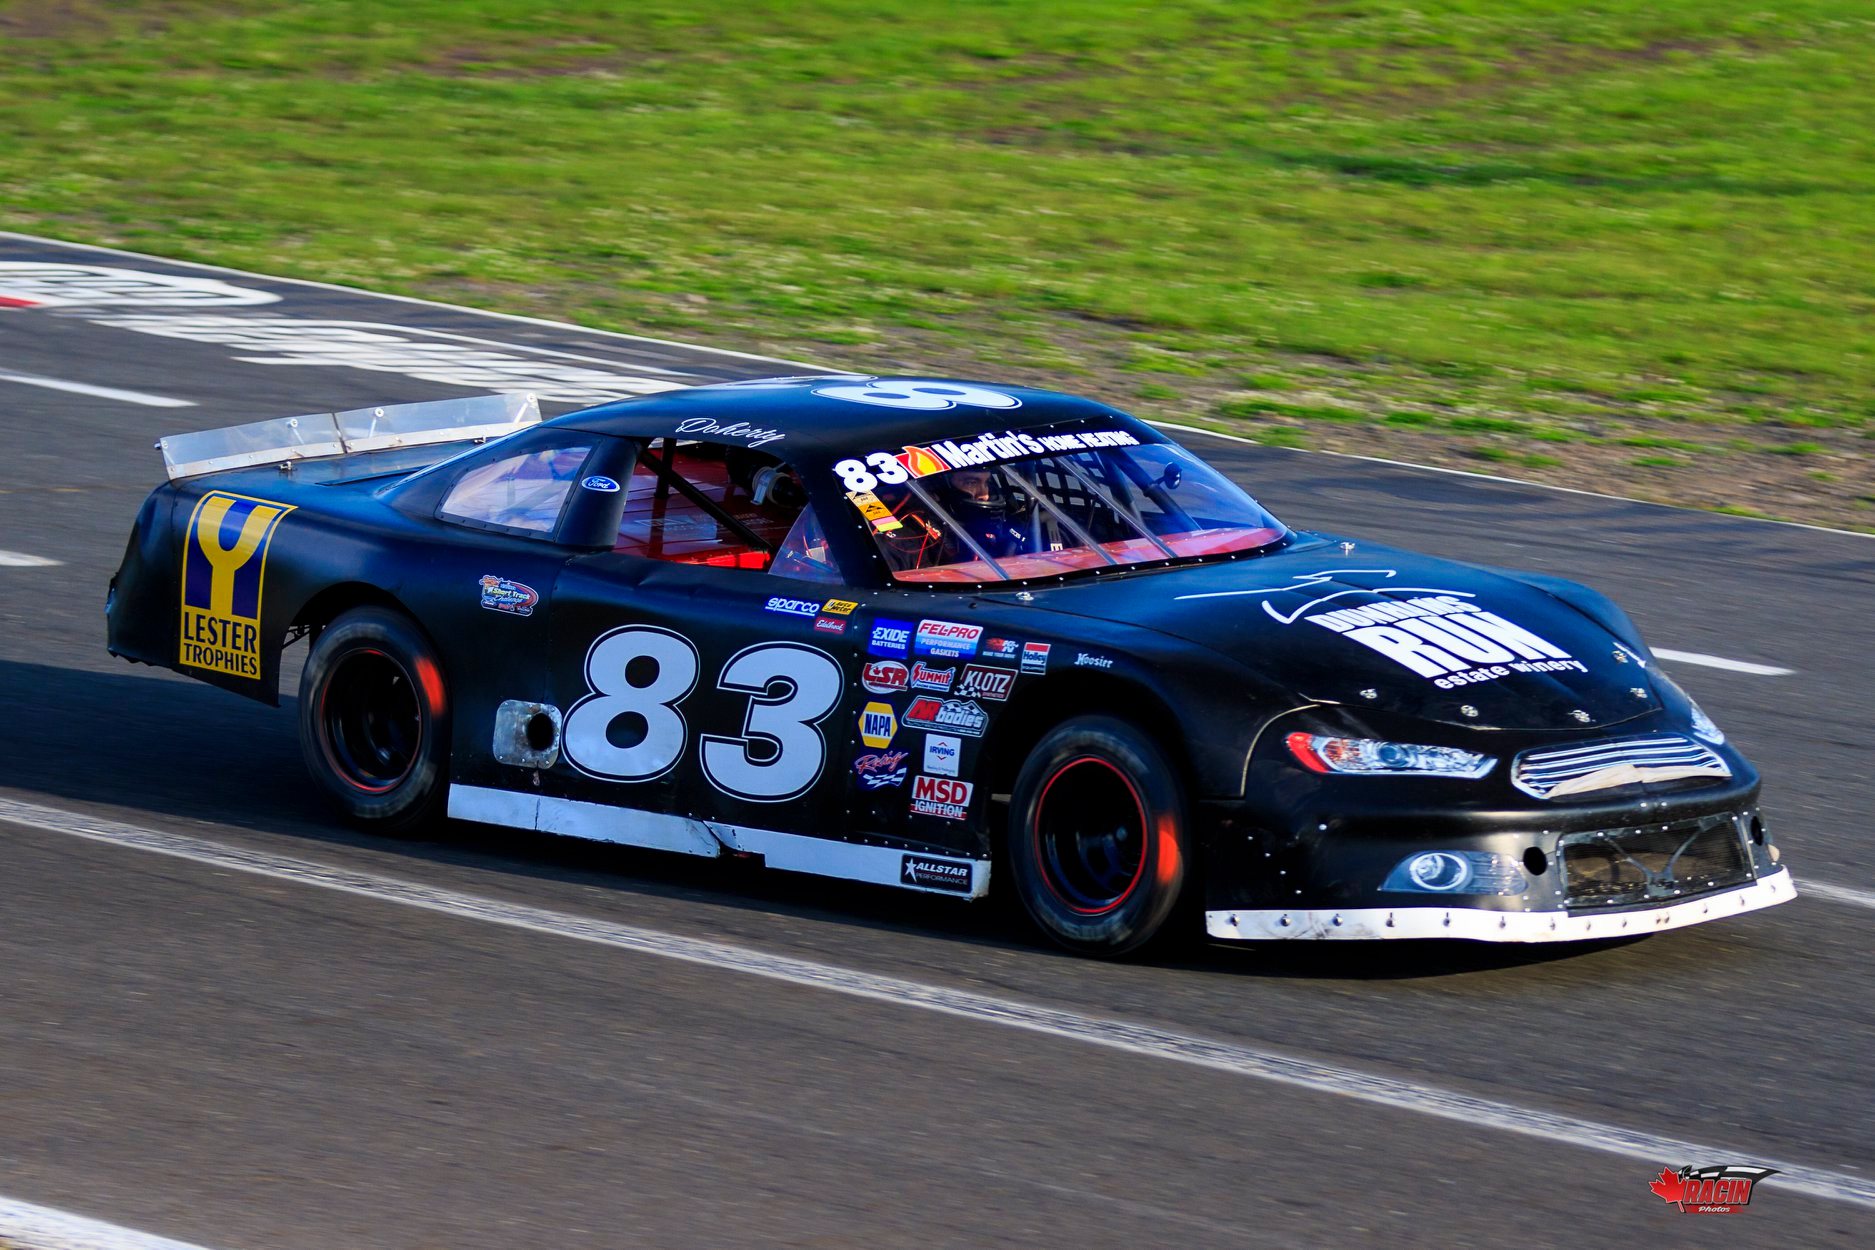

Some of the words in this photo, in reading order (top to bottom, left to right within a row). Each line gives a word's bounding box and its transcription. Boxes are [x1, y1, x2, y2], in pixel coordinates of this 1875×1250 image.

[675, 417, 786, 448] Doherty
[835, 451, 909, 492] 83
[930, 430, 1045, 469] Martin's
[1038, 434, 1088, 452] HOME
[1076, 430, 1141, 449] HEATING
[766, 596, 820, 614] sparco
[183, 611, 258, 655] LESTER
[872, 626, 911, 643] EXIDE
[918, 622, 980, 640] FEL-PRO
[871, 639, 906, 650] BATTERIES
[920, 638, 972, 650] PERFORMANCE
[930, 647, 960, 658] GASKETS
[1341, 610, 1573, 679] RUN
[183, 642, 258, 676] TROPHIES
[1073, 652, 1114, 669] Hoosier
[963, 670, 1012, 694] KLOTZ
[1433, 664, 1511, 690] estate
[1508, 659, 1589, 674] winery
[561, 624, 844, 803] 83
[863, 712, 892, 737] NAPA
[929, 745, 955, 757] IRVING
[915, 776, 968, 805] MSD
[914, 799, 964, 818] IGNITION
[915, 861, 968, 877] ALLSTAR
[915, 871, 968, 886] PERFORMANCE
